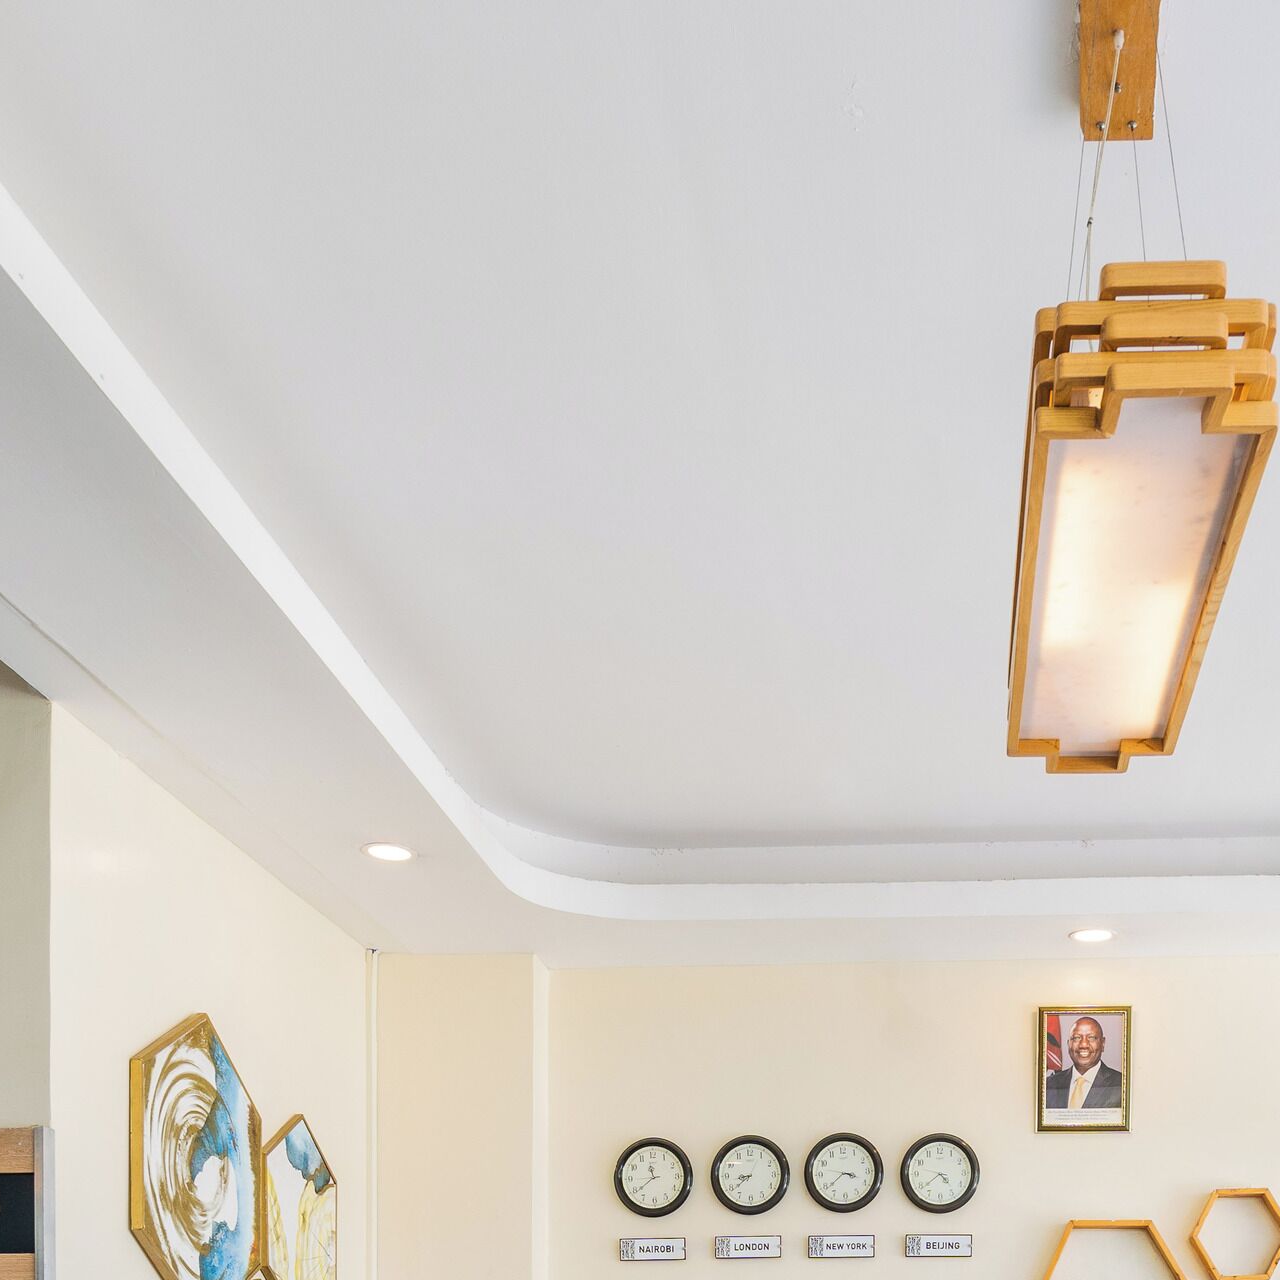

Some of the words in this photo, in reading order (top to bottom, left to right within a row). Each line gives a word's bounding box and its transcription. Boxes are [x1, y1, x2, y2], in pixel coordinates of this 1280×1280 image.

[638, 1245, 675, 1254] NAIROBI
[734, 1243, 770, 1251] LONDON
[846, 1242, 868, 1250] YORK
[925, 1241, 960, 1250] BEIJING
